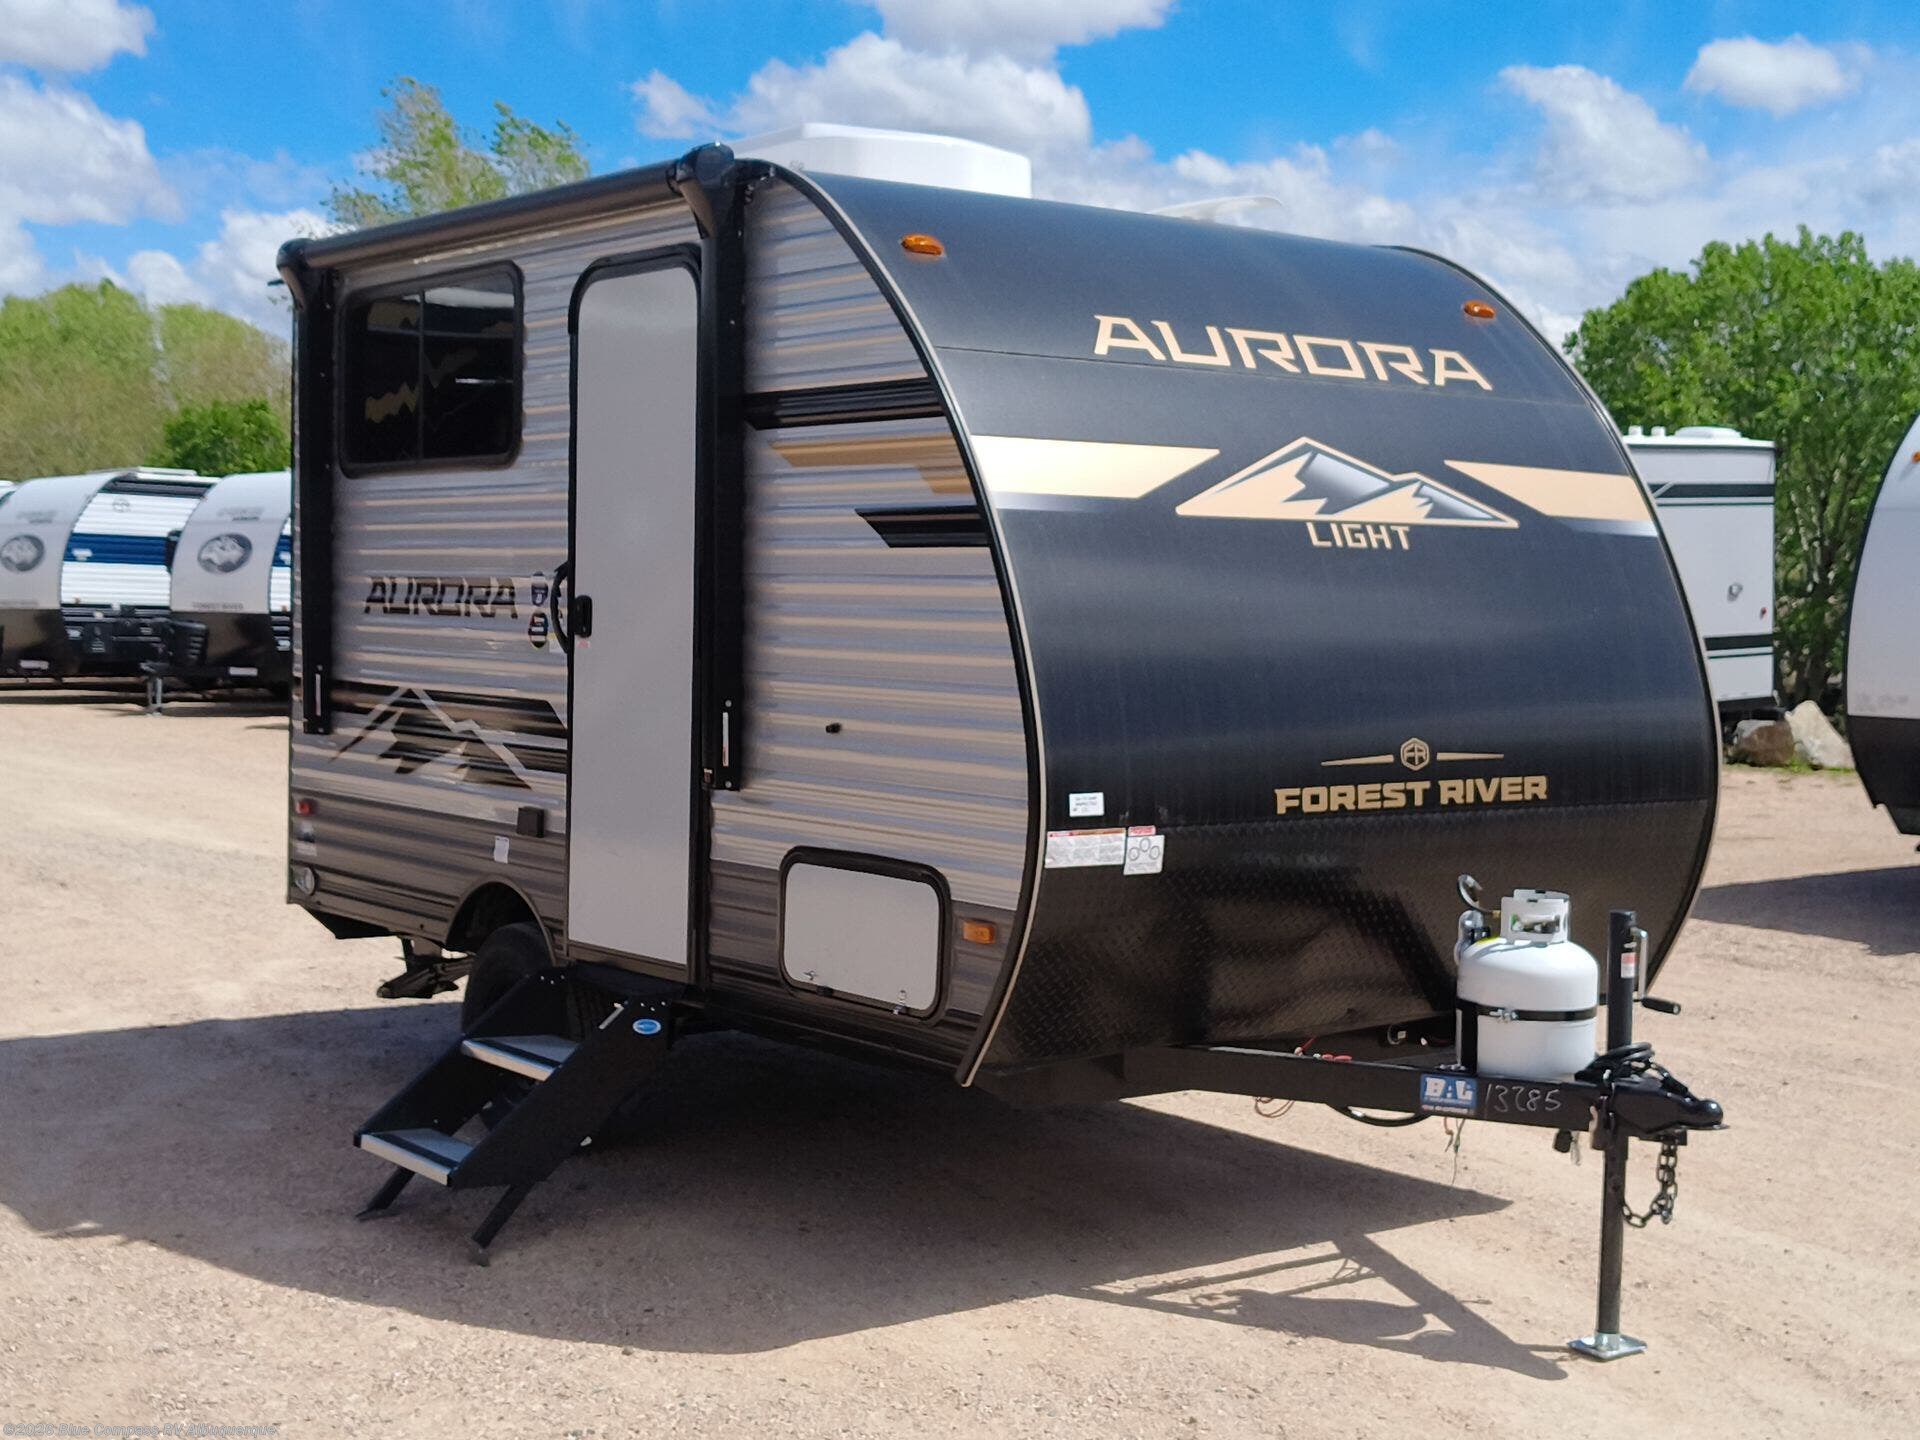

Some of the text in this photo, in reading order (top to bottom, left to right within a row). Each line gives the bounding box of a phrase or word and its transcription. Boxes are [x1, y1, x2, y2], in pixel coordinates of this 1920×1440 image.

[1094, 315, 1493, 391] AURORA
[1306, 521, 1411, 550] LIGHT
[364, 576, 518, 619] AURORA
[1275, 775, 1548, 815] FOREST RIVER
